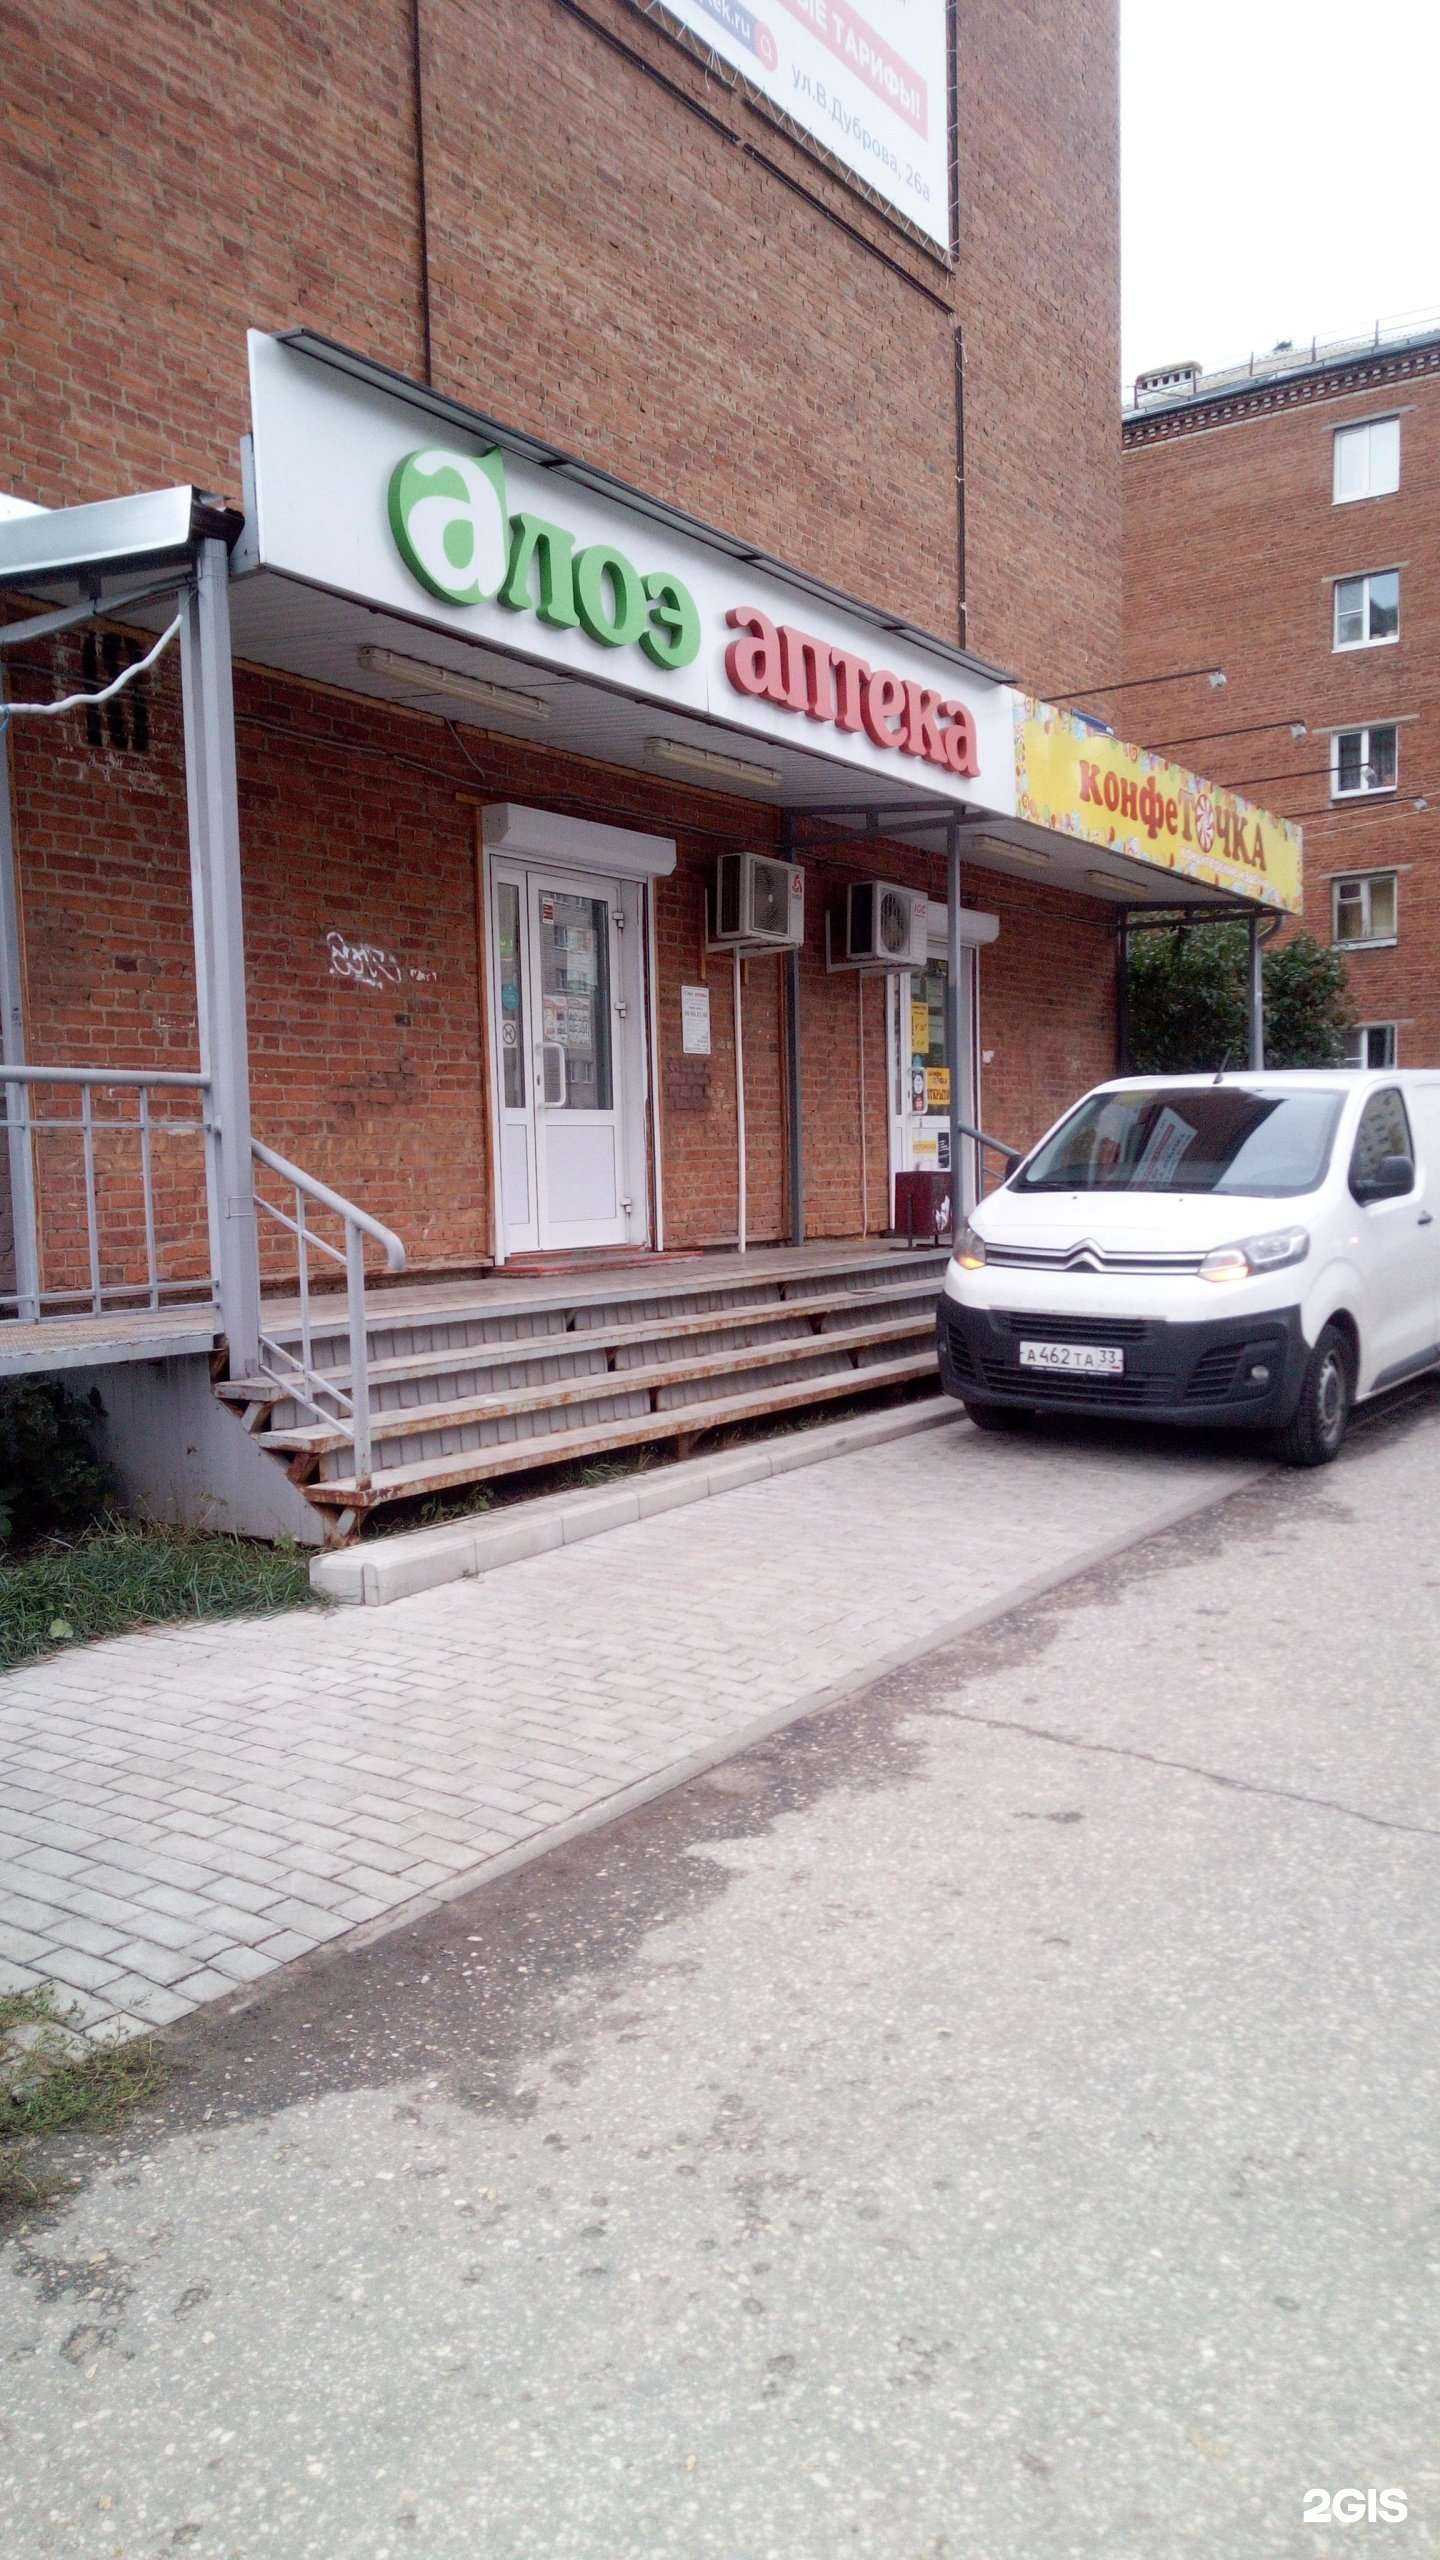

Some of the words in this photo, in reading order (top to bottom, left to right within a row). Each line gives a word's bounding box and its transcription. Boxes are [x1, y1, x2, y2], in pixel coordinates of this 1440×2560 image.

[905, 163, 931, 203] 26а
[387, 445, 701, 671] алоэ
[725, 605, 981, 778] аптека
